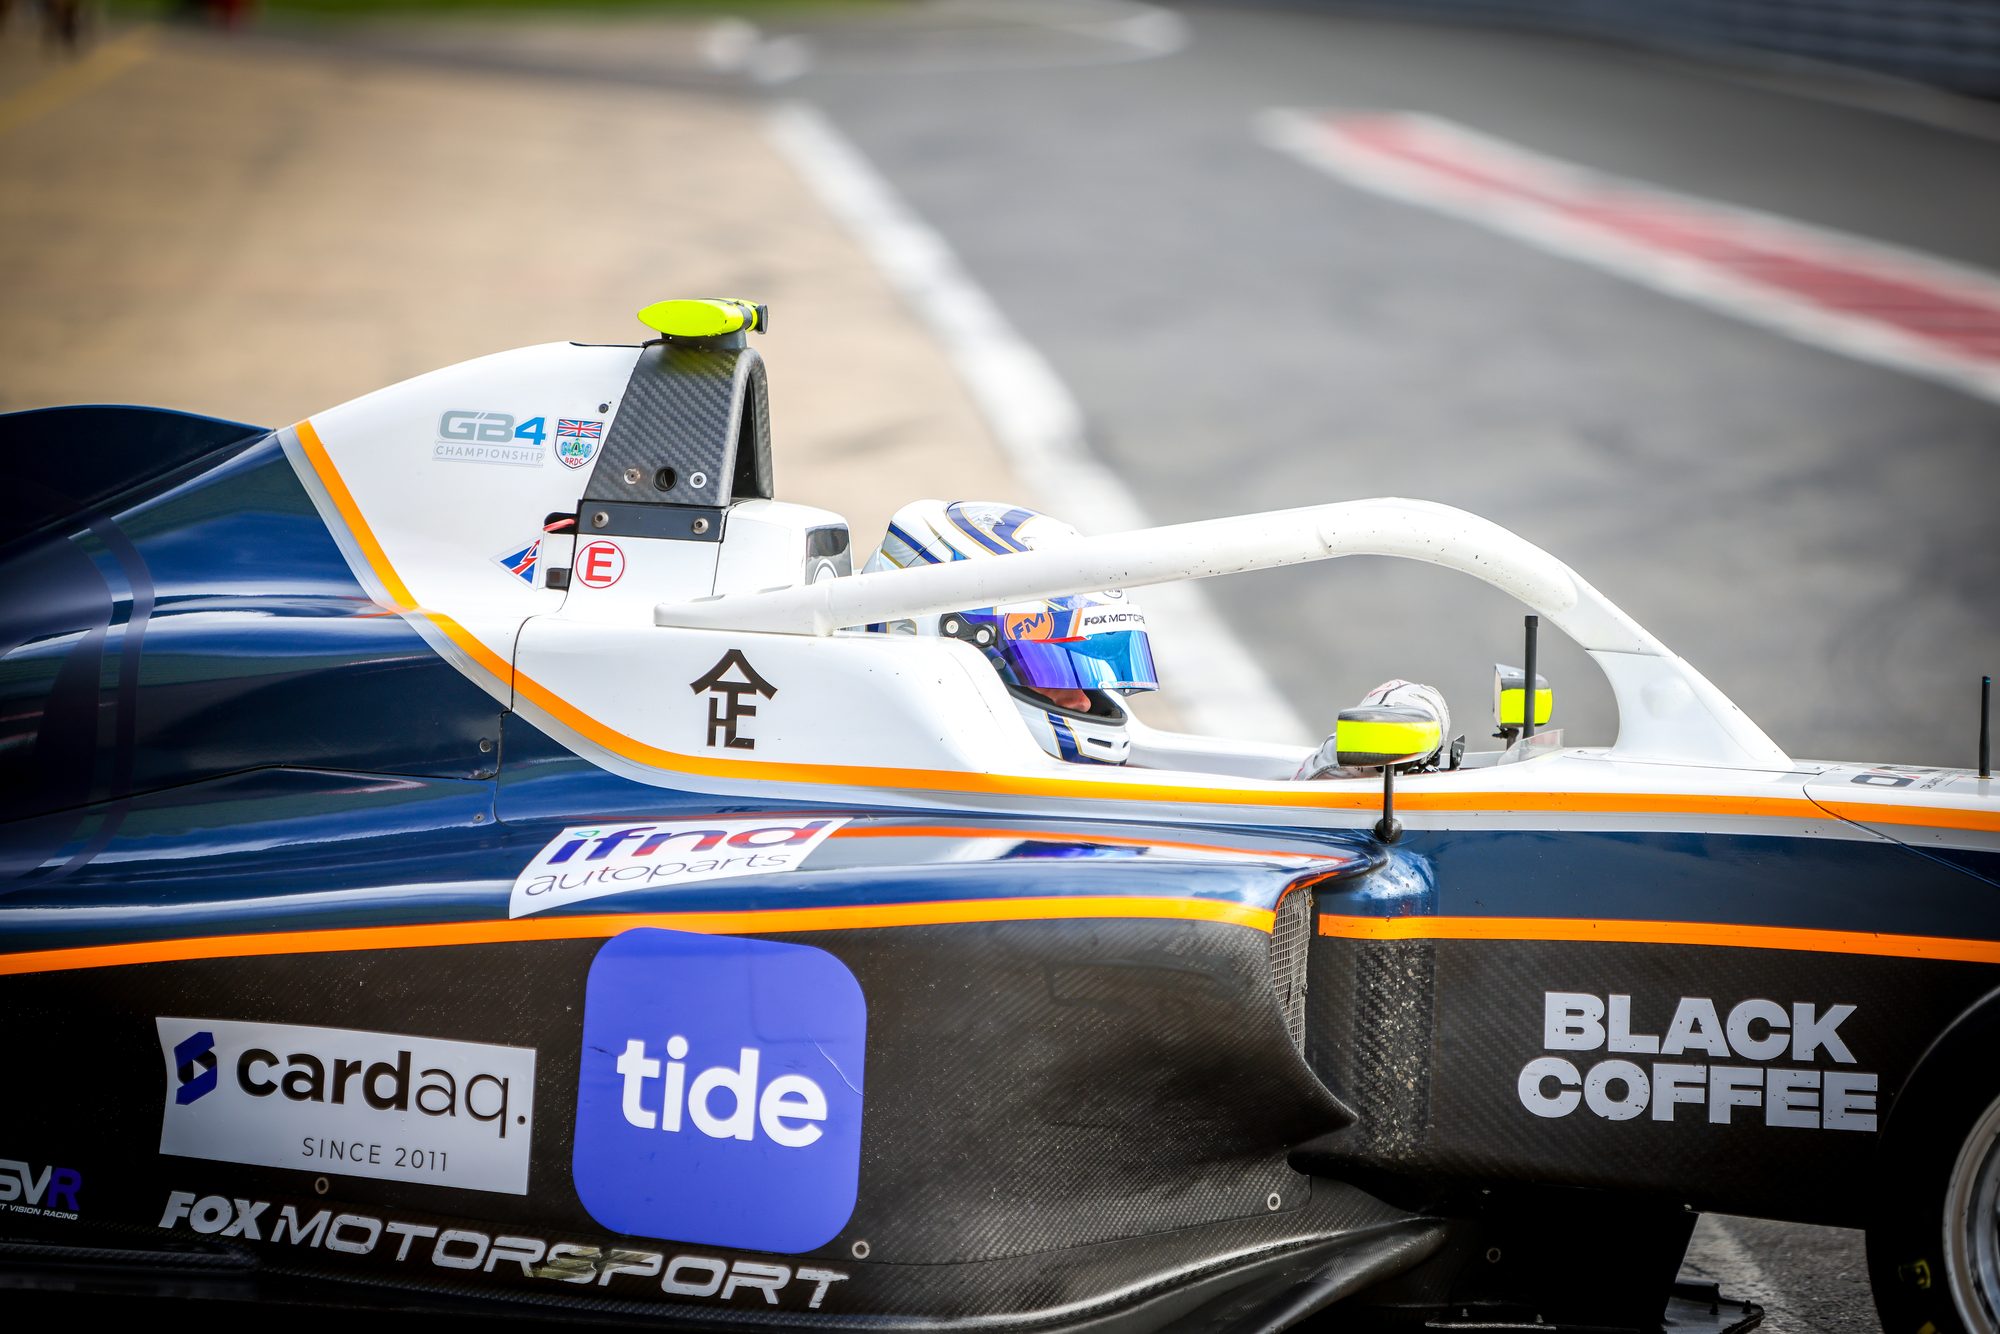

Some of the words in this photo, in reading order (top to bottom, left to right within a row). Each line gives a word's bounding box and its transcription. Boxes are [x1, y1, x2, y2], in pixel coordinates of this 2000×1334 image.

[439, 410, 546, 446] GB4
[435, 445, 545, 462] CHAMPIONSHIP
[584, 546, 616, 583] E
[1084, 614, 1107, 626] FOX
[547, 819, 834, 866] ifnd
[525, 851, 792, 897] autoparts
[1544, 990, 1857, 1064] BLACK
[235, 1047, 527, 1139] cardaq.
[616, 1035, 828, 1149] tide
[1517, 1056, 1879, 1133] COFFEE
[302, 1136, 382, 1165] SINCE
[394, 1147, 449, 1173] 2011
[9, 1204, 42, 1216] VISION
[43, 1209, 79, 1221] RACING
[158, 1190, 274, 1242] FOX
[270, 1204, 850, 1310] MOTORSPORT
